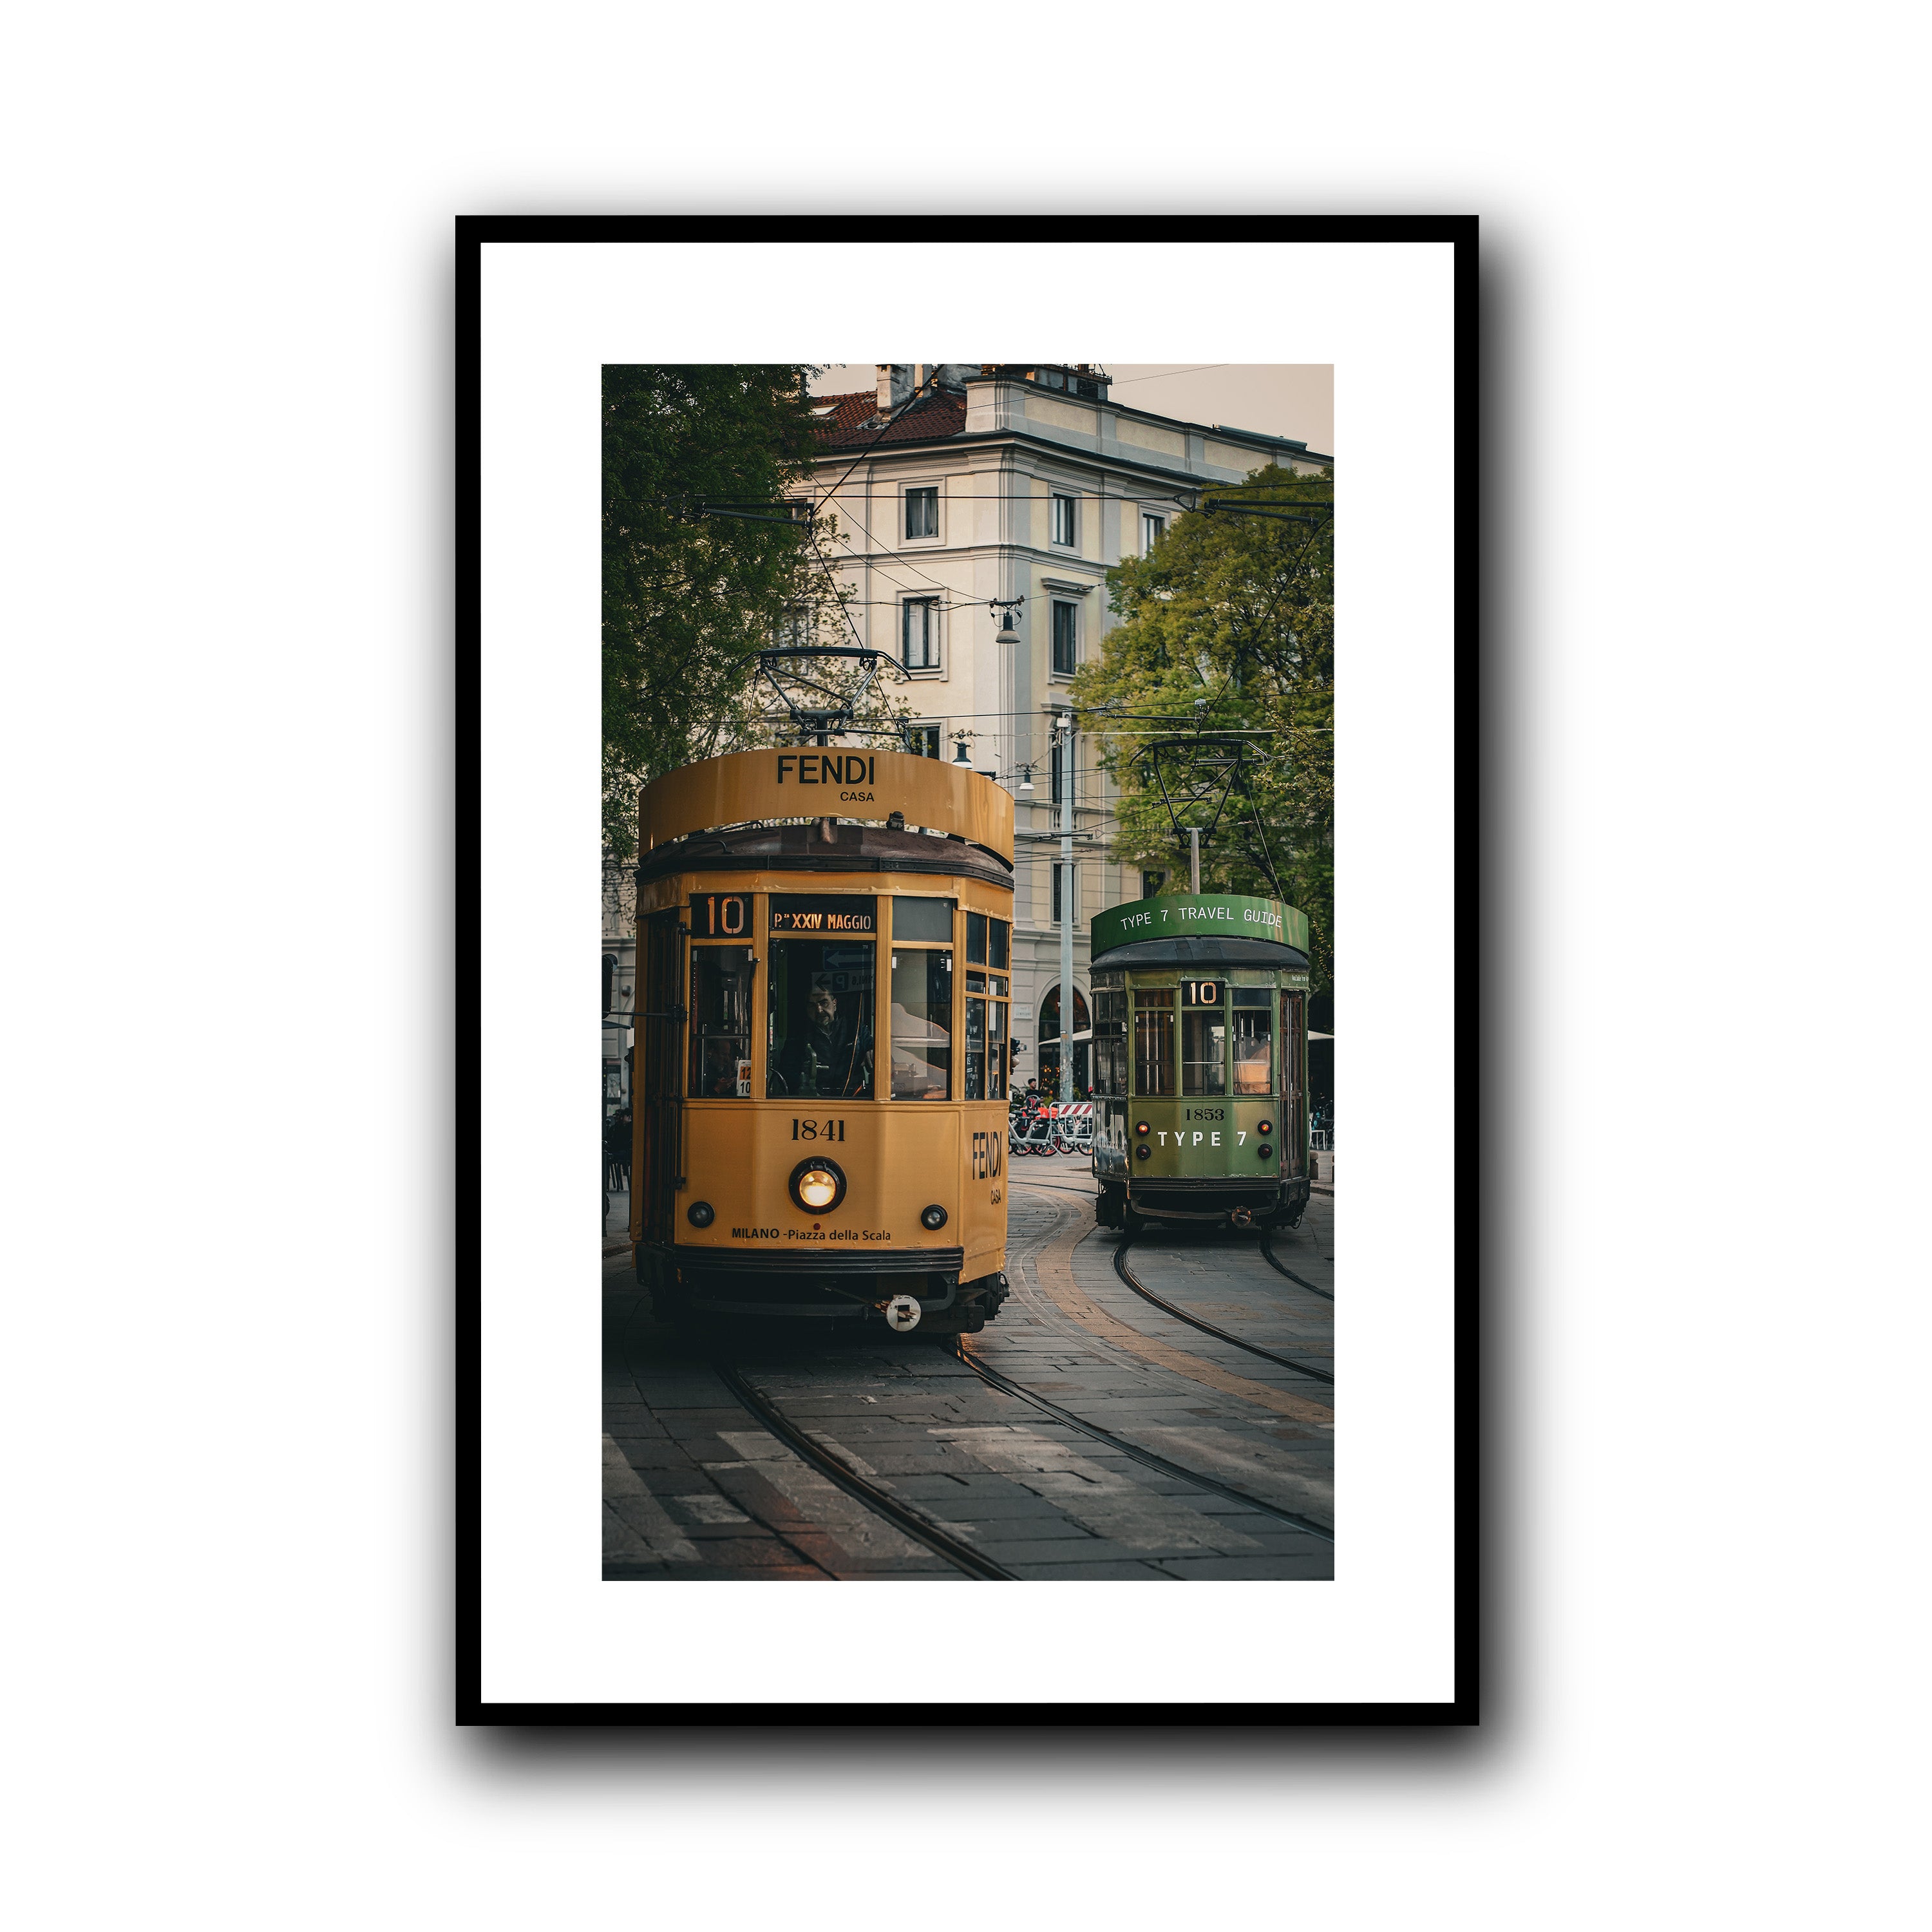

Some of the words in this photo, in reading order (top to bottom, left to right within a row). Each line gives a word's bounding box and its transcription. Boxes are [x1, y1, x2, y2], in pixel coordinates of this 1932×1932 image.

[777, 755, 875, 785] FENDI
[840, 791, 875, 802] CASA
[708, 896, 744, 934] 10
[791, 913, 822, 929] XXIV
[827, 914, 871, 930] MAGGIO
[1121, 912, 1152, 931] TYPE
[1160, 909, 1169, 922] 7
[1178, 907, 1235, 920] TRAVEL
[1244, 909, 1283, 928] GUIDE
[1190, 982, 1217, 1004] 10
[741, 1067, 751, 1080] 12
[741, 1081, 750, 1094] 10
[1186, 1108, 1225, 1121] 1853
[791, 1119, 845, 1141] 1841
[1157, 1132, 1221, 1146] TYPE
[1237, 1132, 1247, 1146] 7
[972, 1131, 1001, 1180] FENDI
[990, 1189, 1001, 1205] CASA
[732, 1227, 780, 1239] MILANO
[829, 1229, 858, 1240] della
[862, 1229, 891, 1240] Scala
